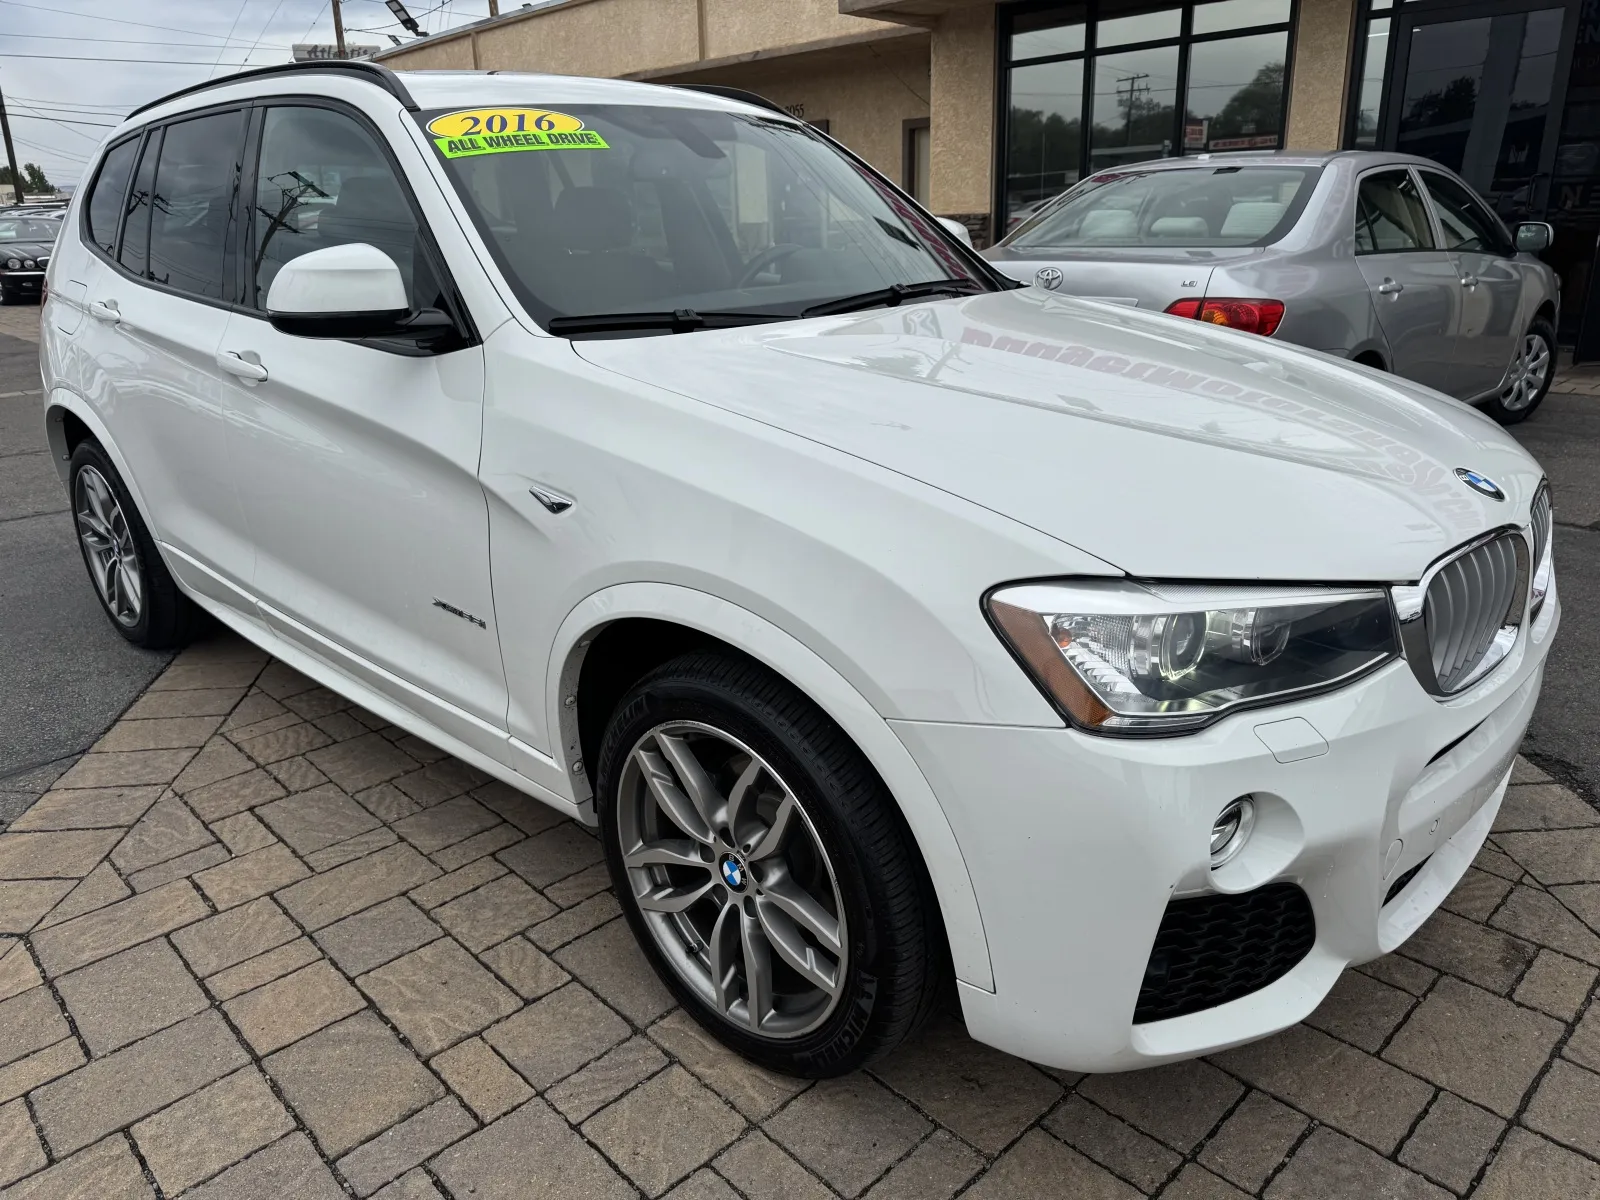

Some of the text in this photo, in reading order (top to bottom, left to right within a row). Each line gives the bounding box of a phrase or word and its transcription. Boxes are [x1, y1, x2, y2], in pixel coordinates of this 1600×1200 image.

[460, 113, 556, 136] 2016
[447, 132, 600, 153] ALL WHEEL DRIVE
